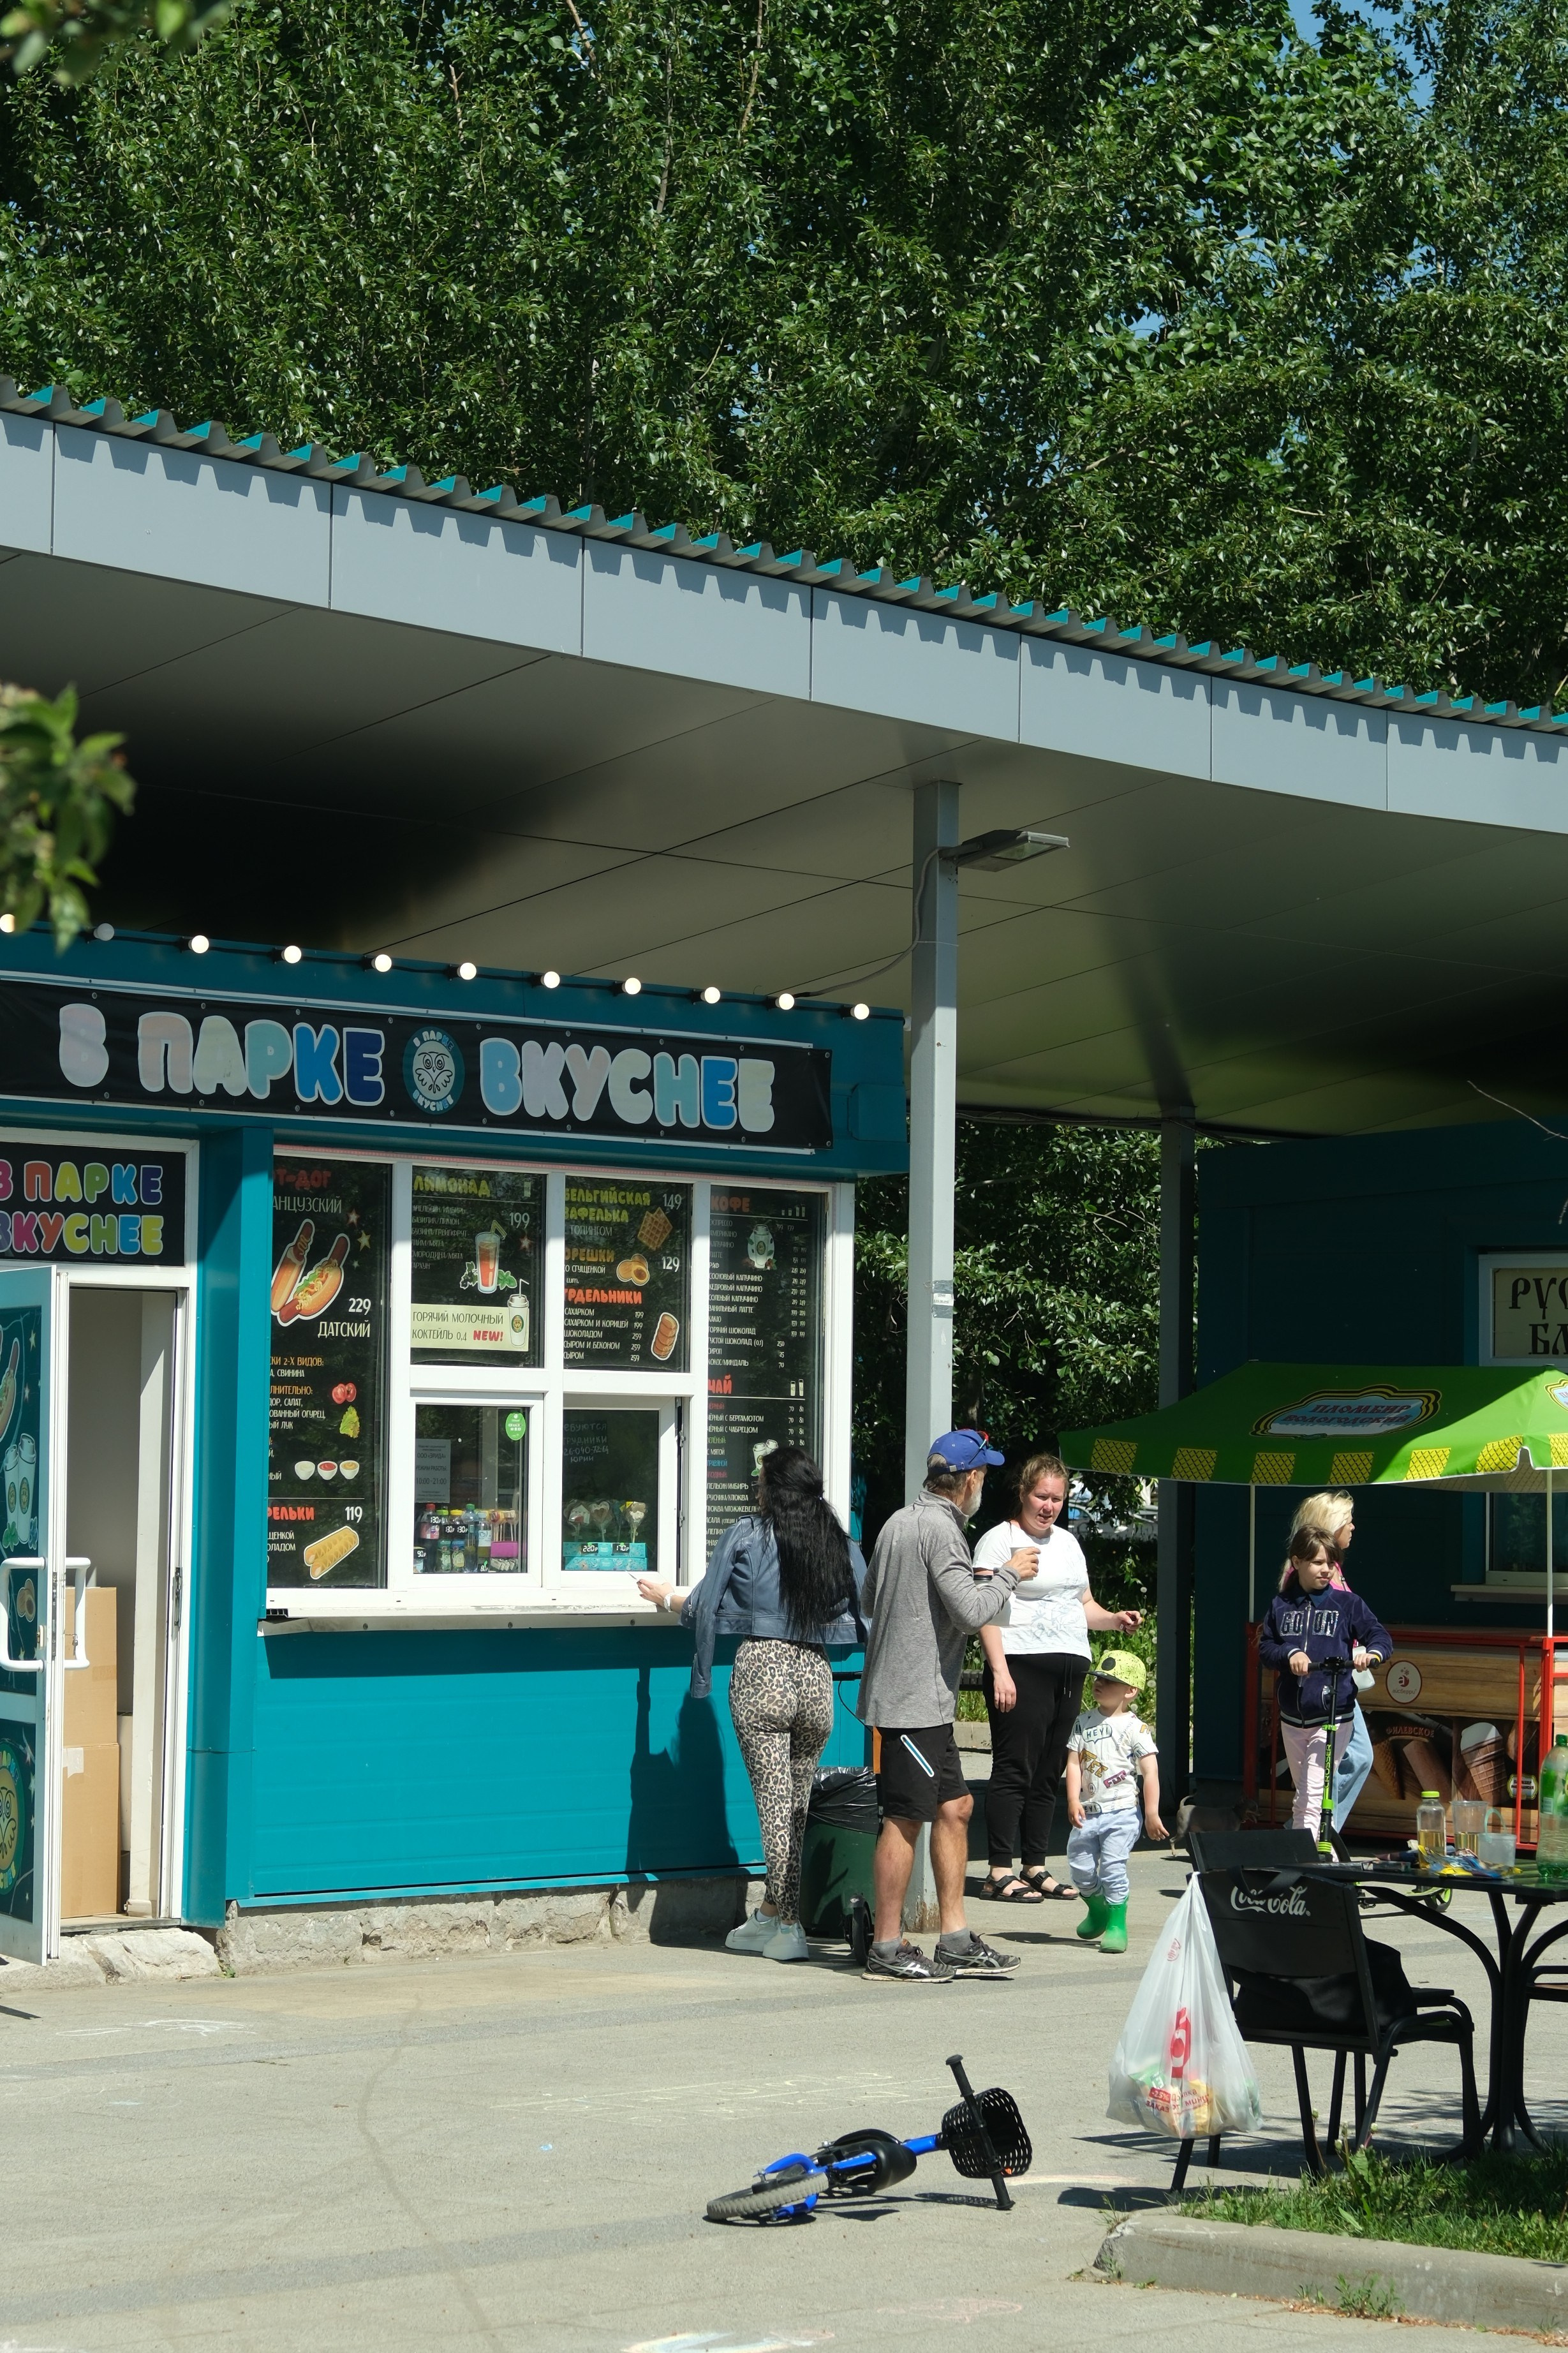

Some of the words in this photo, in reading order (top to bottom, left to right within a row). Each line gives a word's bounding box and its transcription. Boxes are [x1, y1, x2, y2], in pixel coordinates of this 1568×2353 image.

[422, 1030, 454, 1051] ПАРКЕ
[59, 1003, 109, 1087] В
[138, 1011, 385, 1106] ПАРКЕ
[480, 1037, 775, 1132] ВКУСНЕЕ
[412, 1089, 454, 1111] ВКУСНЕЕ
[24, 1161, 163, 1205] ПАРКЕ
[274, 1168, 332, 1191] Т-ДОГ
[413, 1175, 491, 1198] ЛИМОНАД
[663, 1194, 682, 1210] 149
[711, 1196, 750, 1212] КОФЕ
[509, 1212, 530, 1229] 199
[569, 1224, 612, 1236] ТОПИНГОМ
[565, 1247, 615, 1263] ОРЕШКИ
[662, 1256, 680, 1273] 129
[572, 1265, 605, 1275] СГУЩЕНКОЙ
[736, 1274, 763, 1282] КАПУЧИНО
[731, 1295, 758, 1303] КАПУЧИНО
[348, 1298, 371, 1316] 229
[565, 1307, 595, 1316] САХАРКОМ
[635, 1311, 644, 1319] 199
[413, 1310, 448, 1323] ГОРЯЧИЙ
[452, 1313, 503, 1325] МОЛОЧНЫЙ
[318, 1320, 371, 1338] ДАТСКИЙ
[564, 1318, 594, 1328] САХАРКОМ
[602, 1319, 628, 1330] КОРИЦЕЙ
[633, 1322, 643, 1330] 199
[412, 1328, 454, 1339] КОКТЕЙЛЬ
[473, 1330, 503, 1342] NEW!
[564, 1330, 603, 1339] ШОКОЛАДОМ
[632, 1333, 642, 1341] 259
[563, 1340, 585, 1349] СЫРОМ
[593, 1341, 620, 1350] БЕКОНОМ
[630, 1344, 640, 1352] 259
[725, 1338, 753, 1346] ШОКОЛАД
[297, 1356, 324, 1367] ВИДОВ:
[563, 1351, 584, 1360] СЫРОМ
[630, 1355, 640, 1363] 259
[277, 1369, 305, 1377] СВИНИНА
[708, 1374, 732, 1395] ЧАЙ
[284, 1398, 303, 1407] САЛАТ,
[302, 1410, 326, 1419] ОГУРЕЦ,
[1310, 1404, 1411, 1414] ПЛОМБИР
[280, 1421, 293, 1430] ЛУК
[1281, 1414, 1412, 1425] ВОЛОГОДСКИЙ
[729, 1426, 758, 1434] ЧАБРЕЦОМ
[345, 1506, 363, 1524] 119
[1280, 1612, 1303, 1635] GO
[1313, 1611, 1339, 1636] ON
[1086, 1726, 1109, 1739] HEY!
[1386, 1726, 1435, 1738] ФИЛЕВСКОЕ
[1324, 1744, 1332, 1788] CROSSER
[1151, 2090, 1170, 2102] -25%
[1145, 2100, 1170, 2112] ЗАКАЗ
